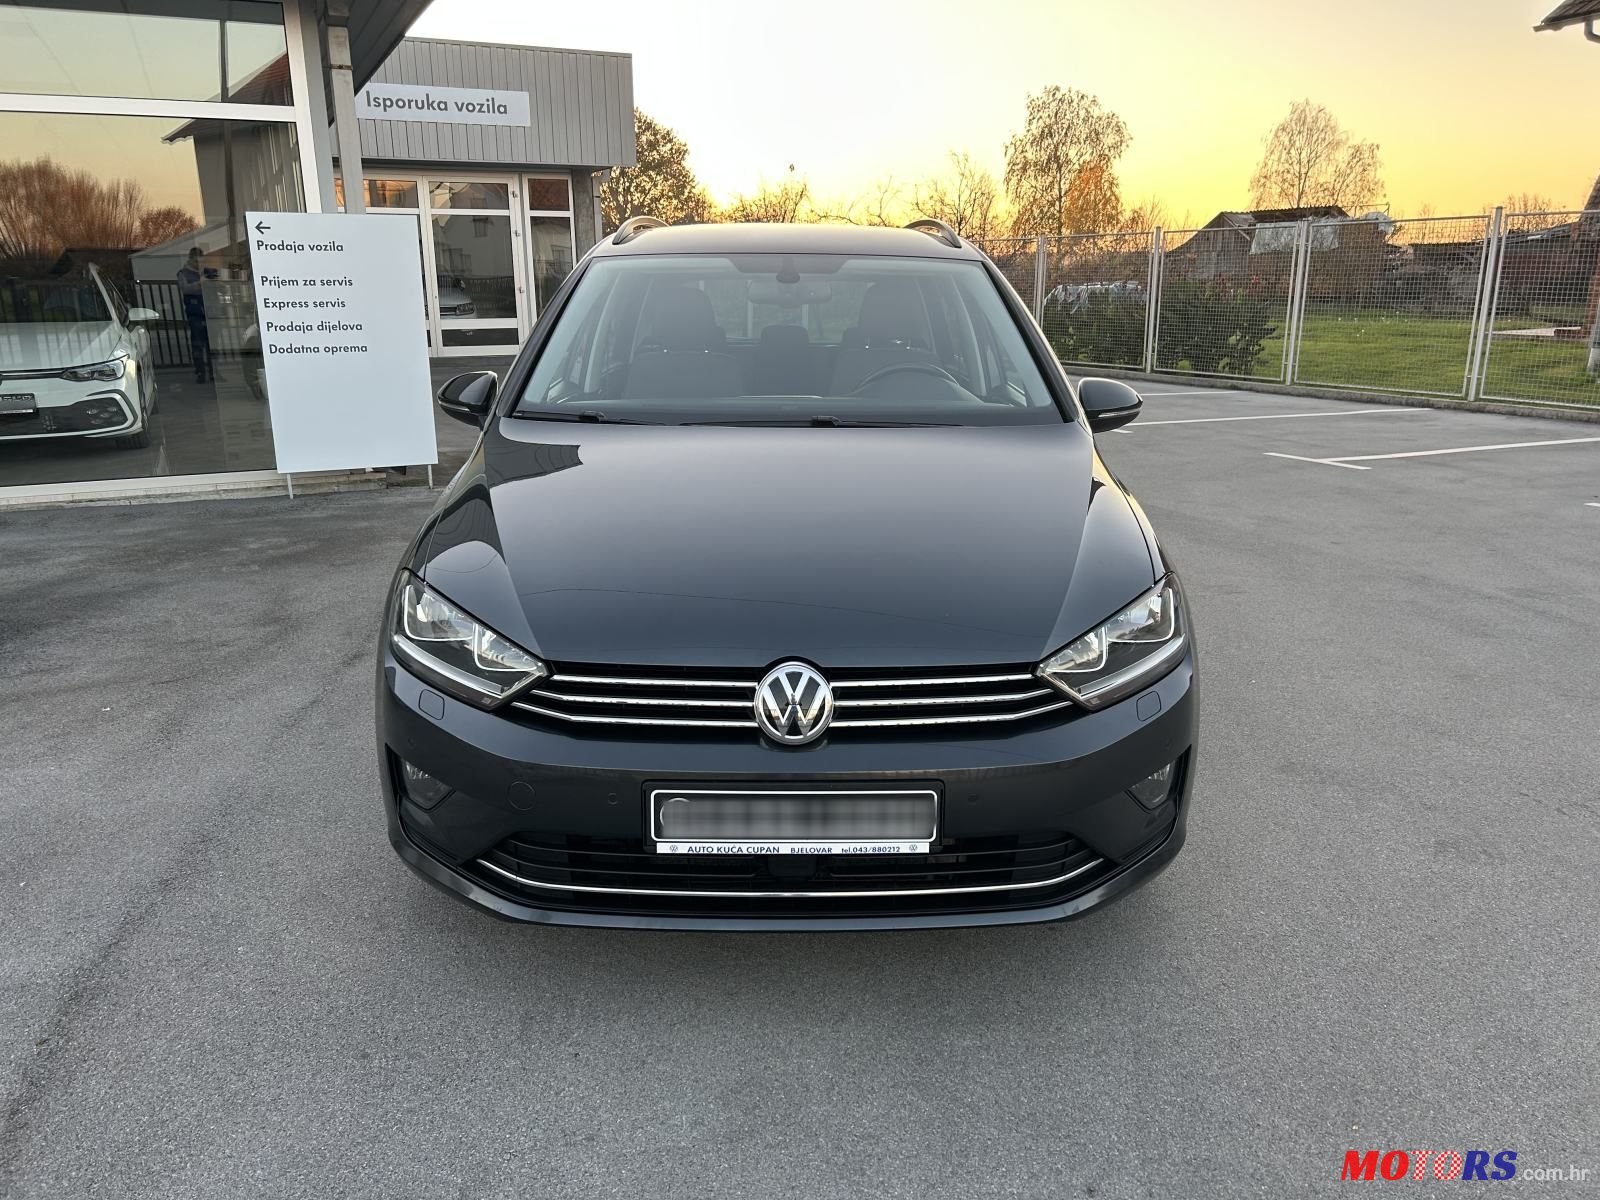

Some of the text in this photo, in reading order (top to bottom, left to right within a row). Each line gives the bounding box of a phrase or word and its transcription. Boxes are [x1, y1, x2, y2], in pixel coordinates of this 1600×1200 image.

[366, 91, 508, 115] Isporuka vozila
[256, 240, 344, 254] Prodaja vozila
[260, 275, 353, 288] Prijem za servis
[264, 298, 346, 309] Express servis
[266, 321, 363, 334] Prodaja dijelova
[269, 343, 368, 354] Dodatna oprema
